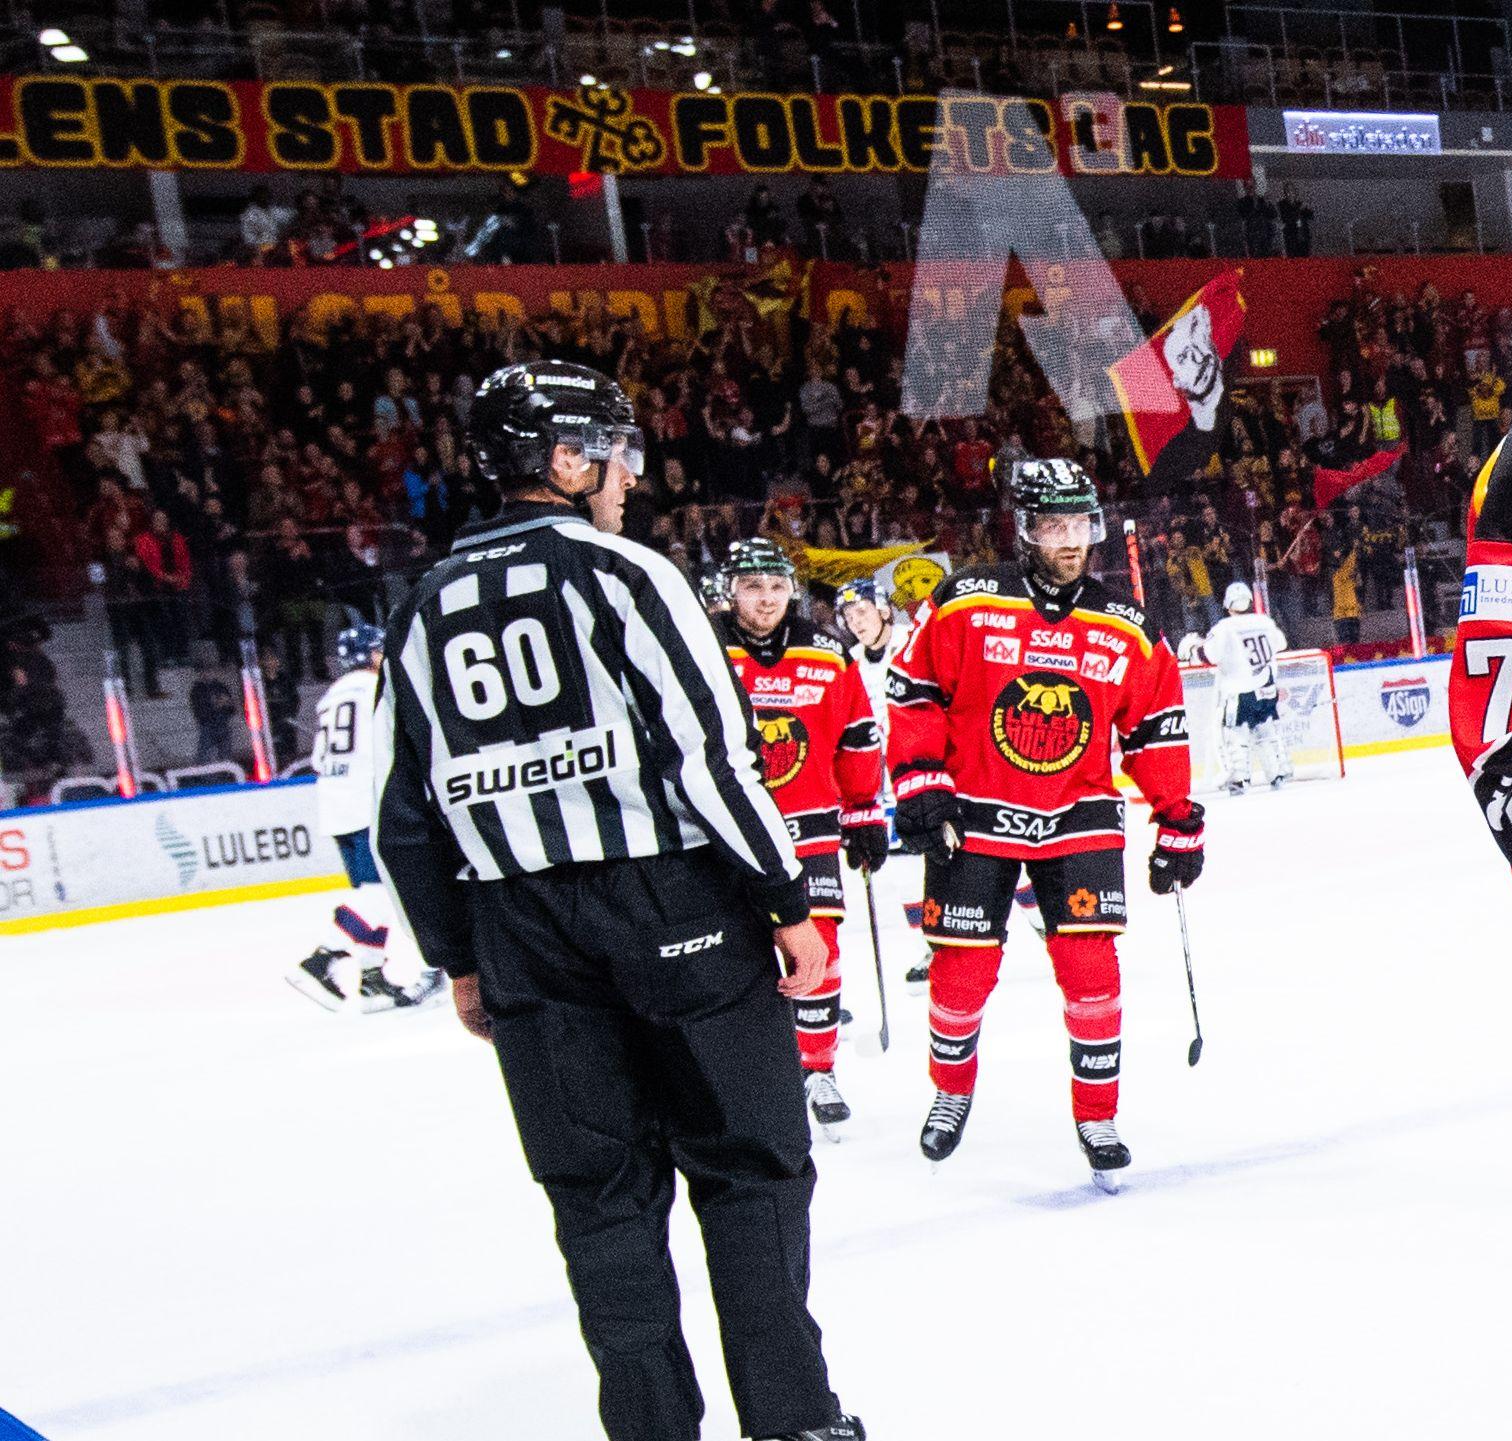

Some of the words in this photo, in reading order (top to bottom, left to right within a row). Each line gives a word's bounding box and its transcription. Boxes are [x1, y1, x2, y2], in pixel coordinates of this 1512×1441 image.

[0, 75, 246, 169] ENS
[261, 82, 538, 170] STAD
[671, 93, 1060, 175] FOLKETS
[467, 543, 526, 562] CCM
[956, 577, 999, 594] SSAB
[1104, 602, 1146, 626] SSAB
[1029, 629, 1074, 650] SSAB
[1242, 634, 1273, 666] 30
[444, 618, 561, 721] 60
[1027, 654, 1076, 668] SCANIA
[754, 677, 792, 692] SSAB
[1386, 692, 1428, 721] 4Sign
[446, 730, 617, 806] swedol
[203, 823, 313, 870] LULEBO
[944, 903, 984, 919] Luleå
[943, 918, 991, 932] Energi
[659, 931, 724, 958] CCM
[1081, 1053, 1118, 1069] NEX
